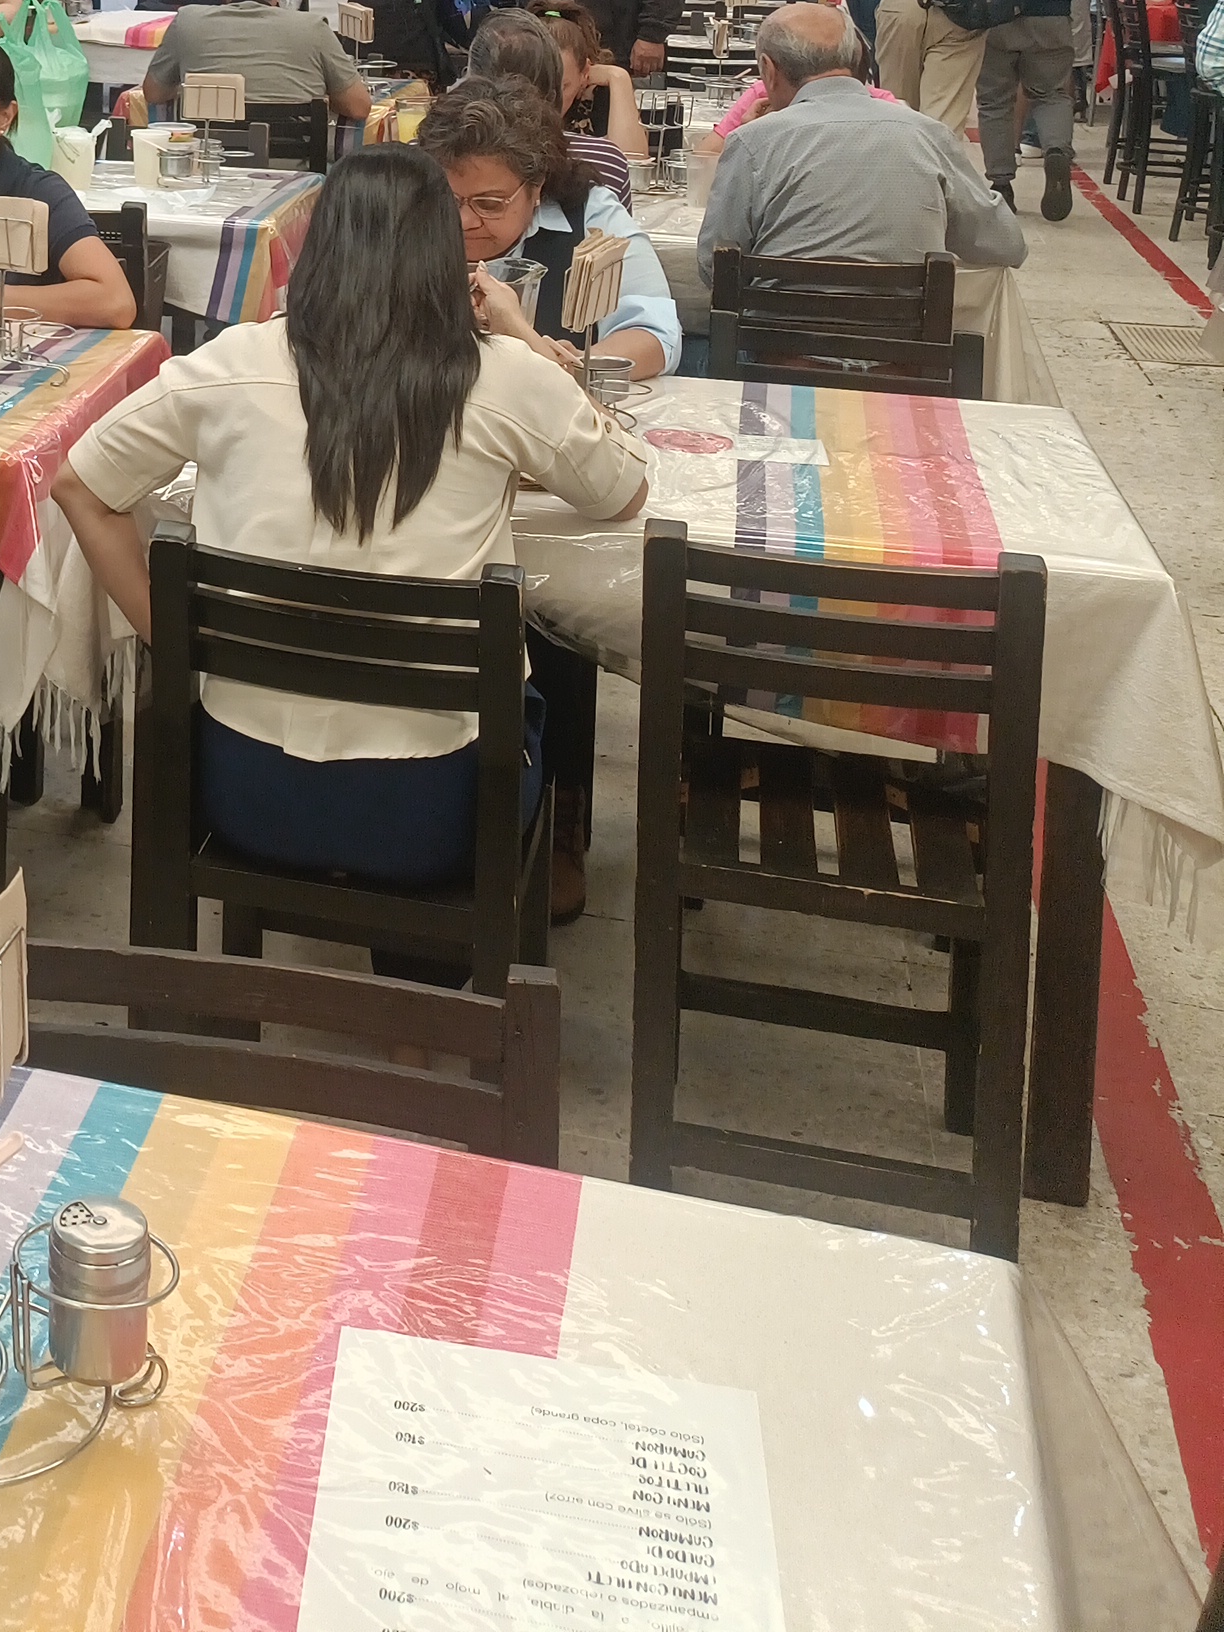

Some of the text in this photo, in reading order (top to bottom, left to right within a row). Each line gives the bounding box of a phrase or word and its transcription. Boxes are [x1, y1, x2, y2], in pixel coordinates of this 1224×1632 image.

[394, 1399, 426, 1413] $200
[530, 1406, 580, 1421] grande)
[583, 1416, 616, 1428] copa
[588, 1499, 614, 1511] con
[385, 1515, 420, 1531] $200
[379, 1587, 415, 1604] $200
